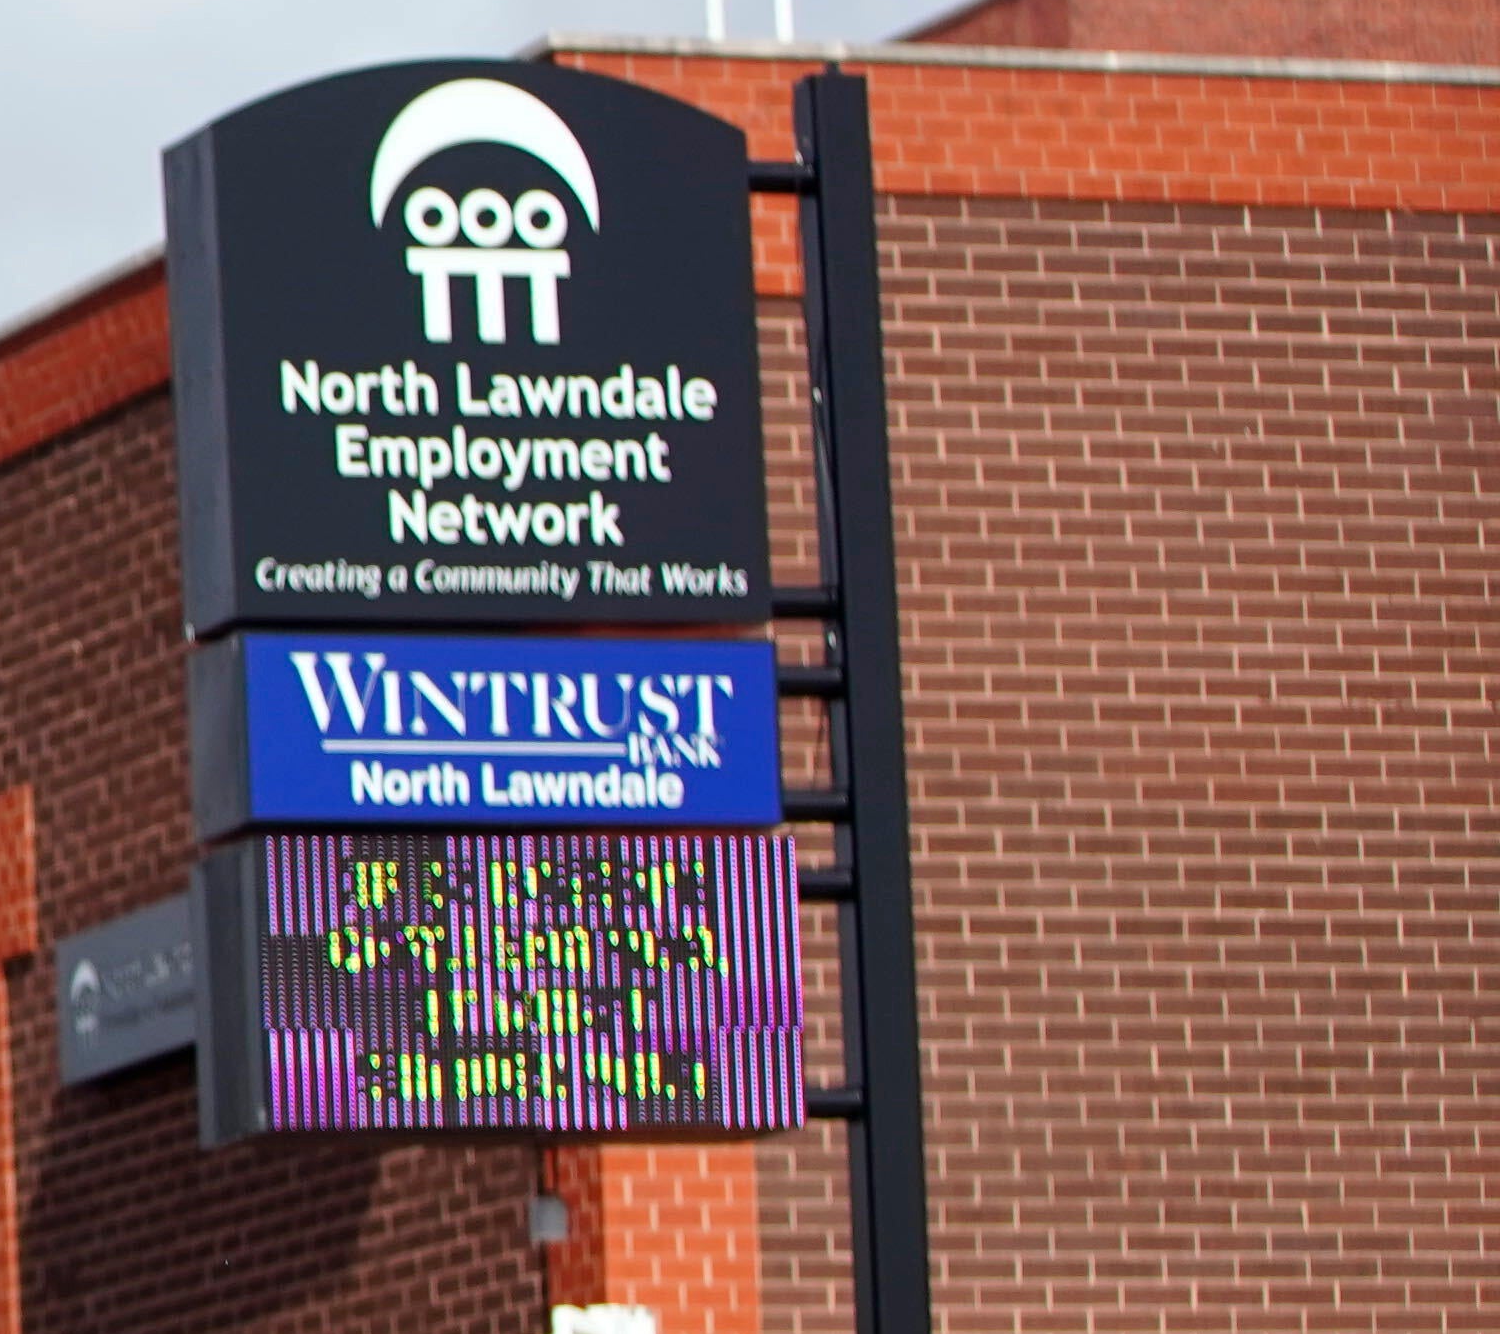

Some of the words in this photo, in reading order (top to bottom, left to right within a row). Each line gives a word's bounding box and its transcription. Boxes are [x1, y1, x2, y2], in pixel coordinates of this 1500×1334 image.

[280, 359, 439, 416] North
[456, 362, 718, 421] Lawndale
[335, 424, 672, 492] Employment
[388, 489, 625, 547] Network
[255, 557, 382, 598] Creating
[387, 565, 409, 593] a
[414, 558, 581, 602] Community
[586, 560, 652, 596] That
[661, 562, 749, 597] Works
[628, 731, 722, 768] BANK
[350, 760, 471, 806] North
[481, 761, 685, 809] Lawndale
